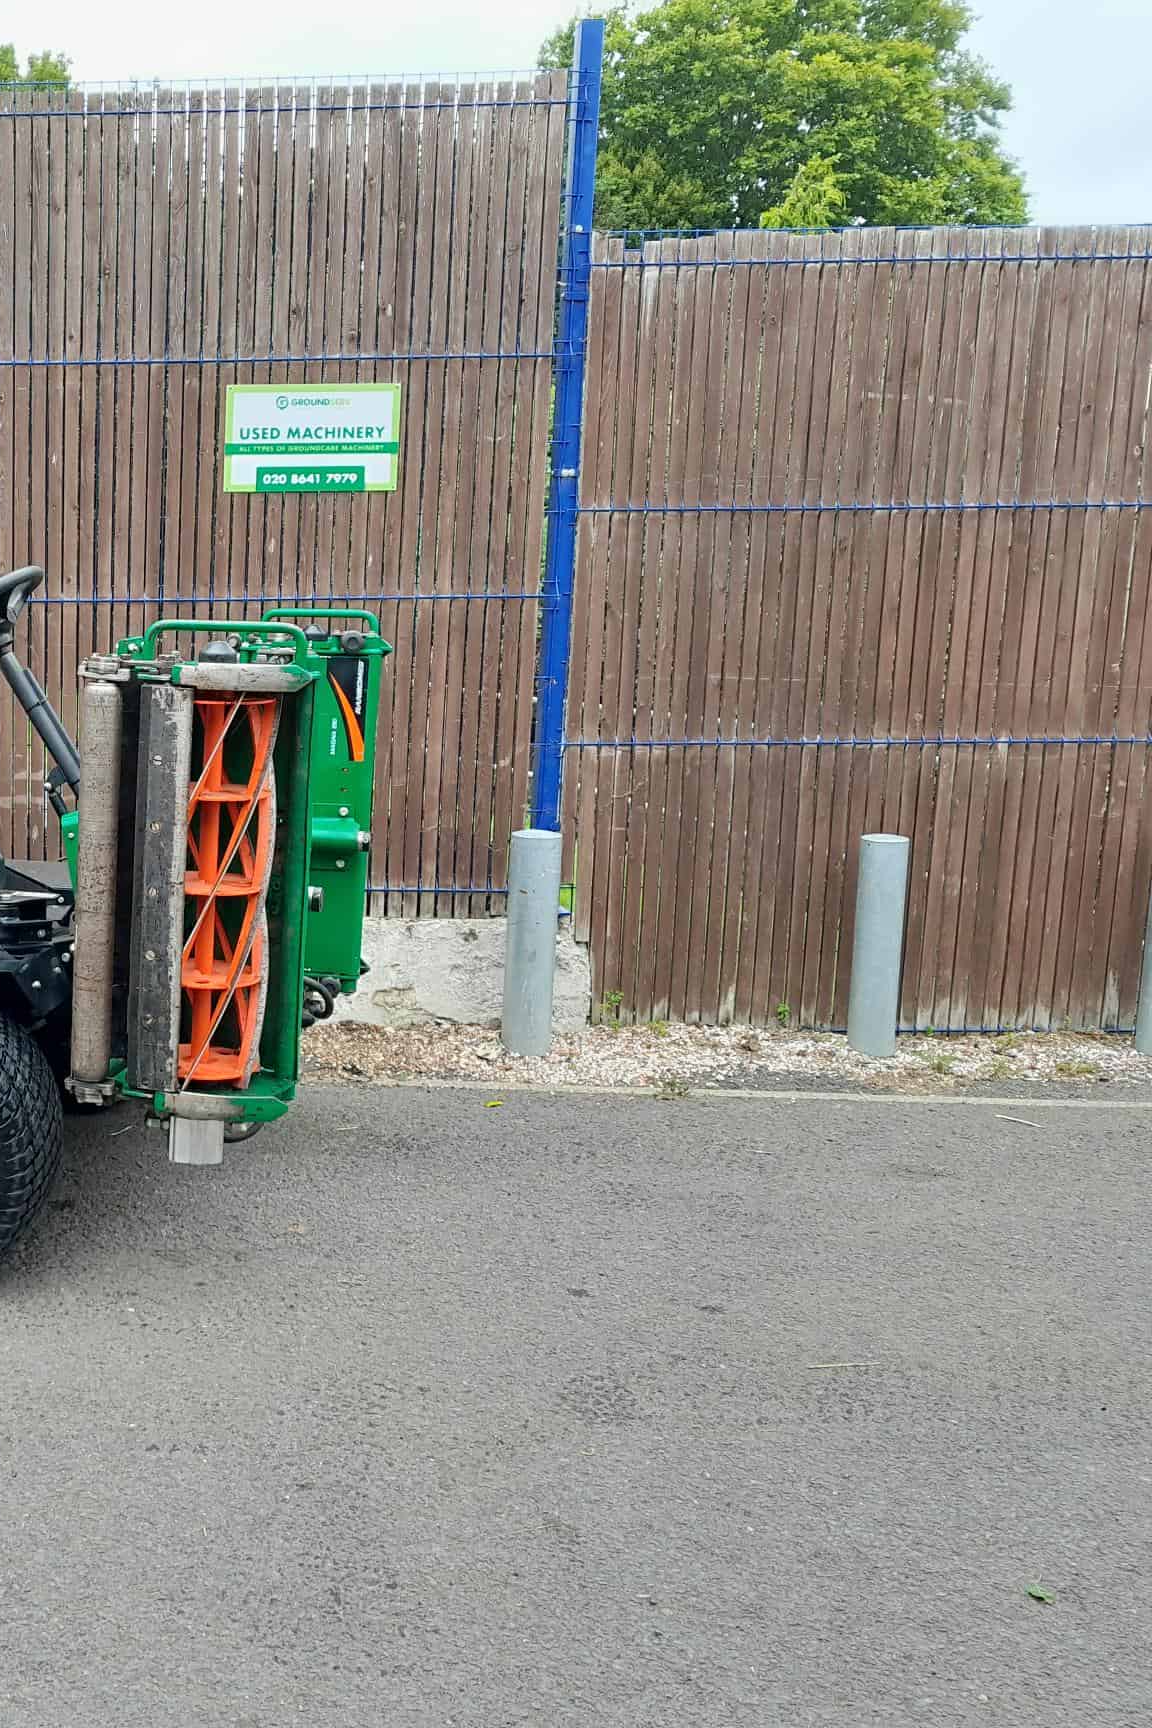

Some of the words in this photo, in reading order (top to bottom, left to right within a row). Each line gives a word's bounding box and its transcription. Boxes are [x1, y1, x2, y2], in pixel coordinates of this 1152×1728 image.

[240, 427, 280, 440] USED
[287, 426, 384, 439] MACHINERY
[263, 473, 287, 485] 020
[291, 473, 320, 485] 8641
[326, 472, 358, 484] 7979
